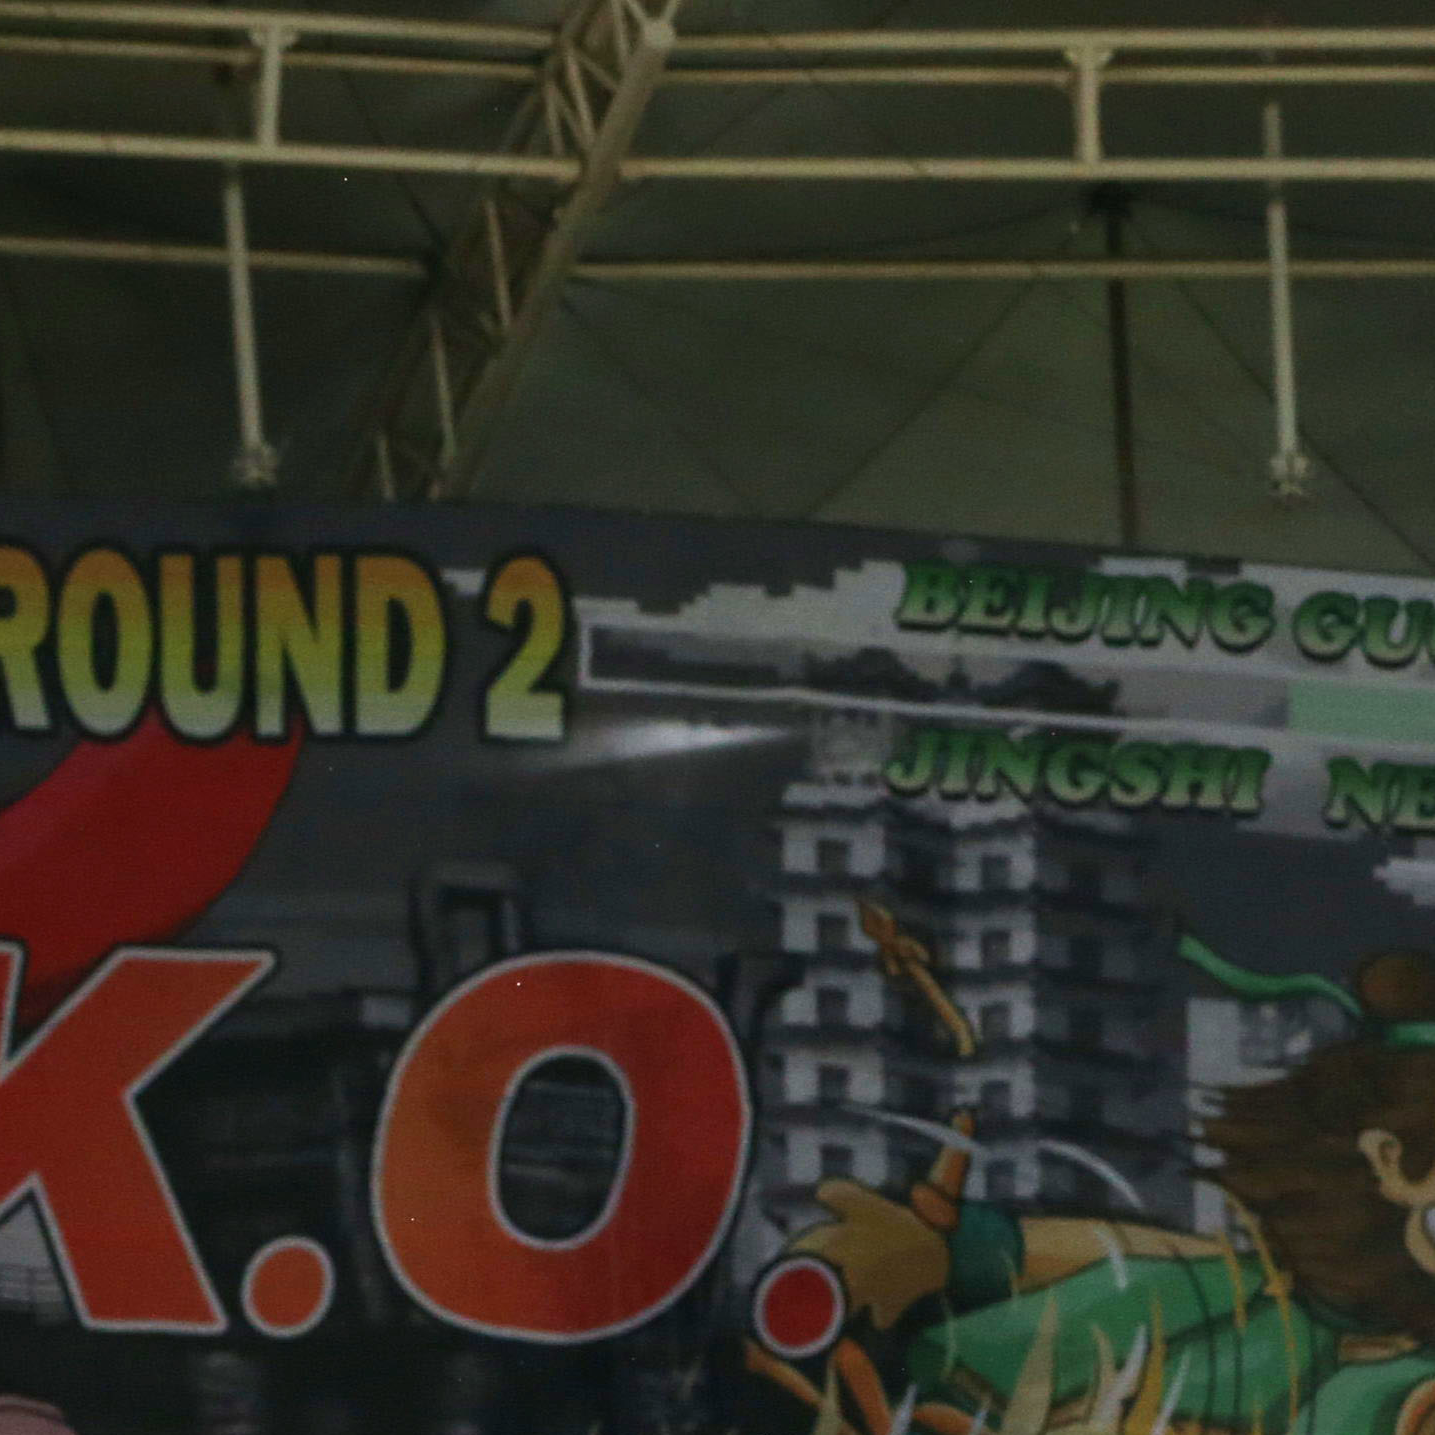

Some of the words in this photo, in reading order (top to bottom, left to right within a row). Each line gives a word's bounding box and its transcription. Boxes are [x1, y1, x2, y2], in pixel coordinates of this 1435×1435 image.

[478, 552, 571, 744] 2
[896, 560, 1279, 656] BEIJING
[883, 725, 1273, 820] JINGSHI
